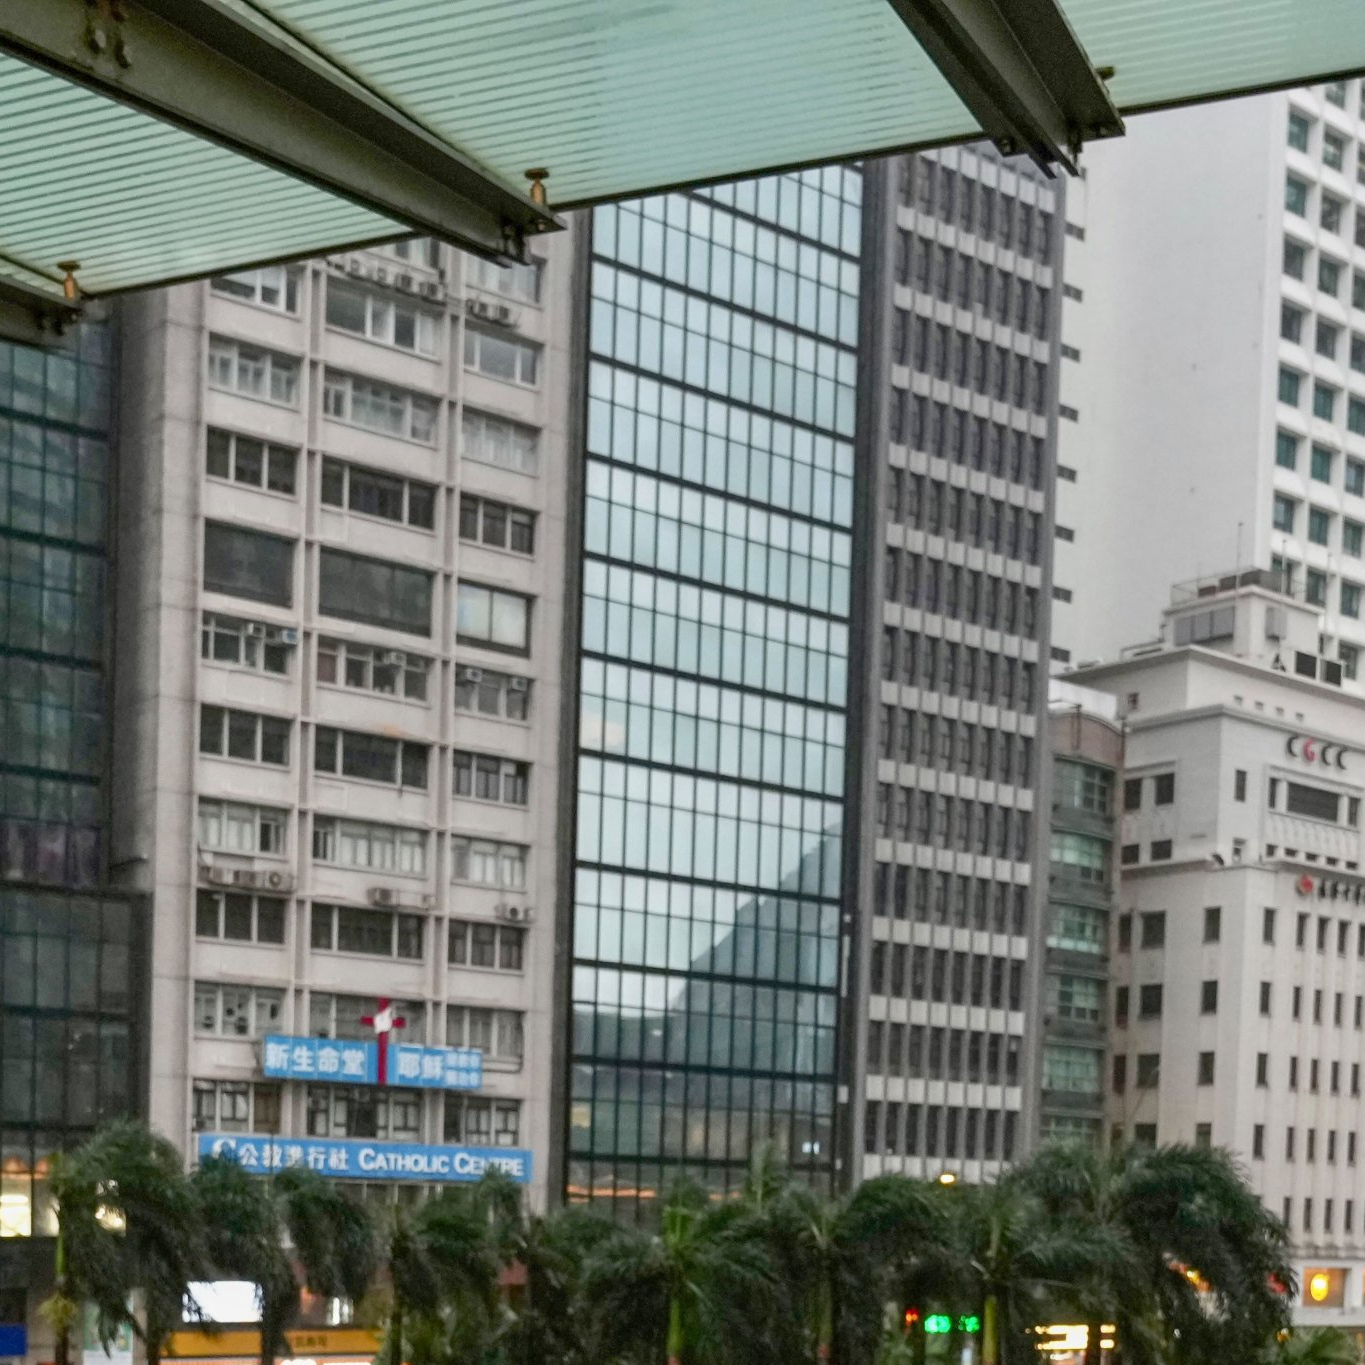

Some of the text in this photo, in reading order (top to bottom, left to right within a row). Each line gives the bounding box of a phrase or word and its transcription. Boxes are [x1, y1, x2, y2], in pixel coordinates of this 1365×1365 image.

[1286, 735, 1348, 771] CGCC
[265, 1042, 365, 1076] 新生命堂
[358, 1148, 449, 1174] CATHOLIC
